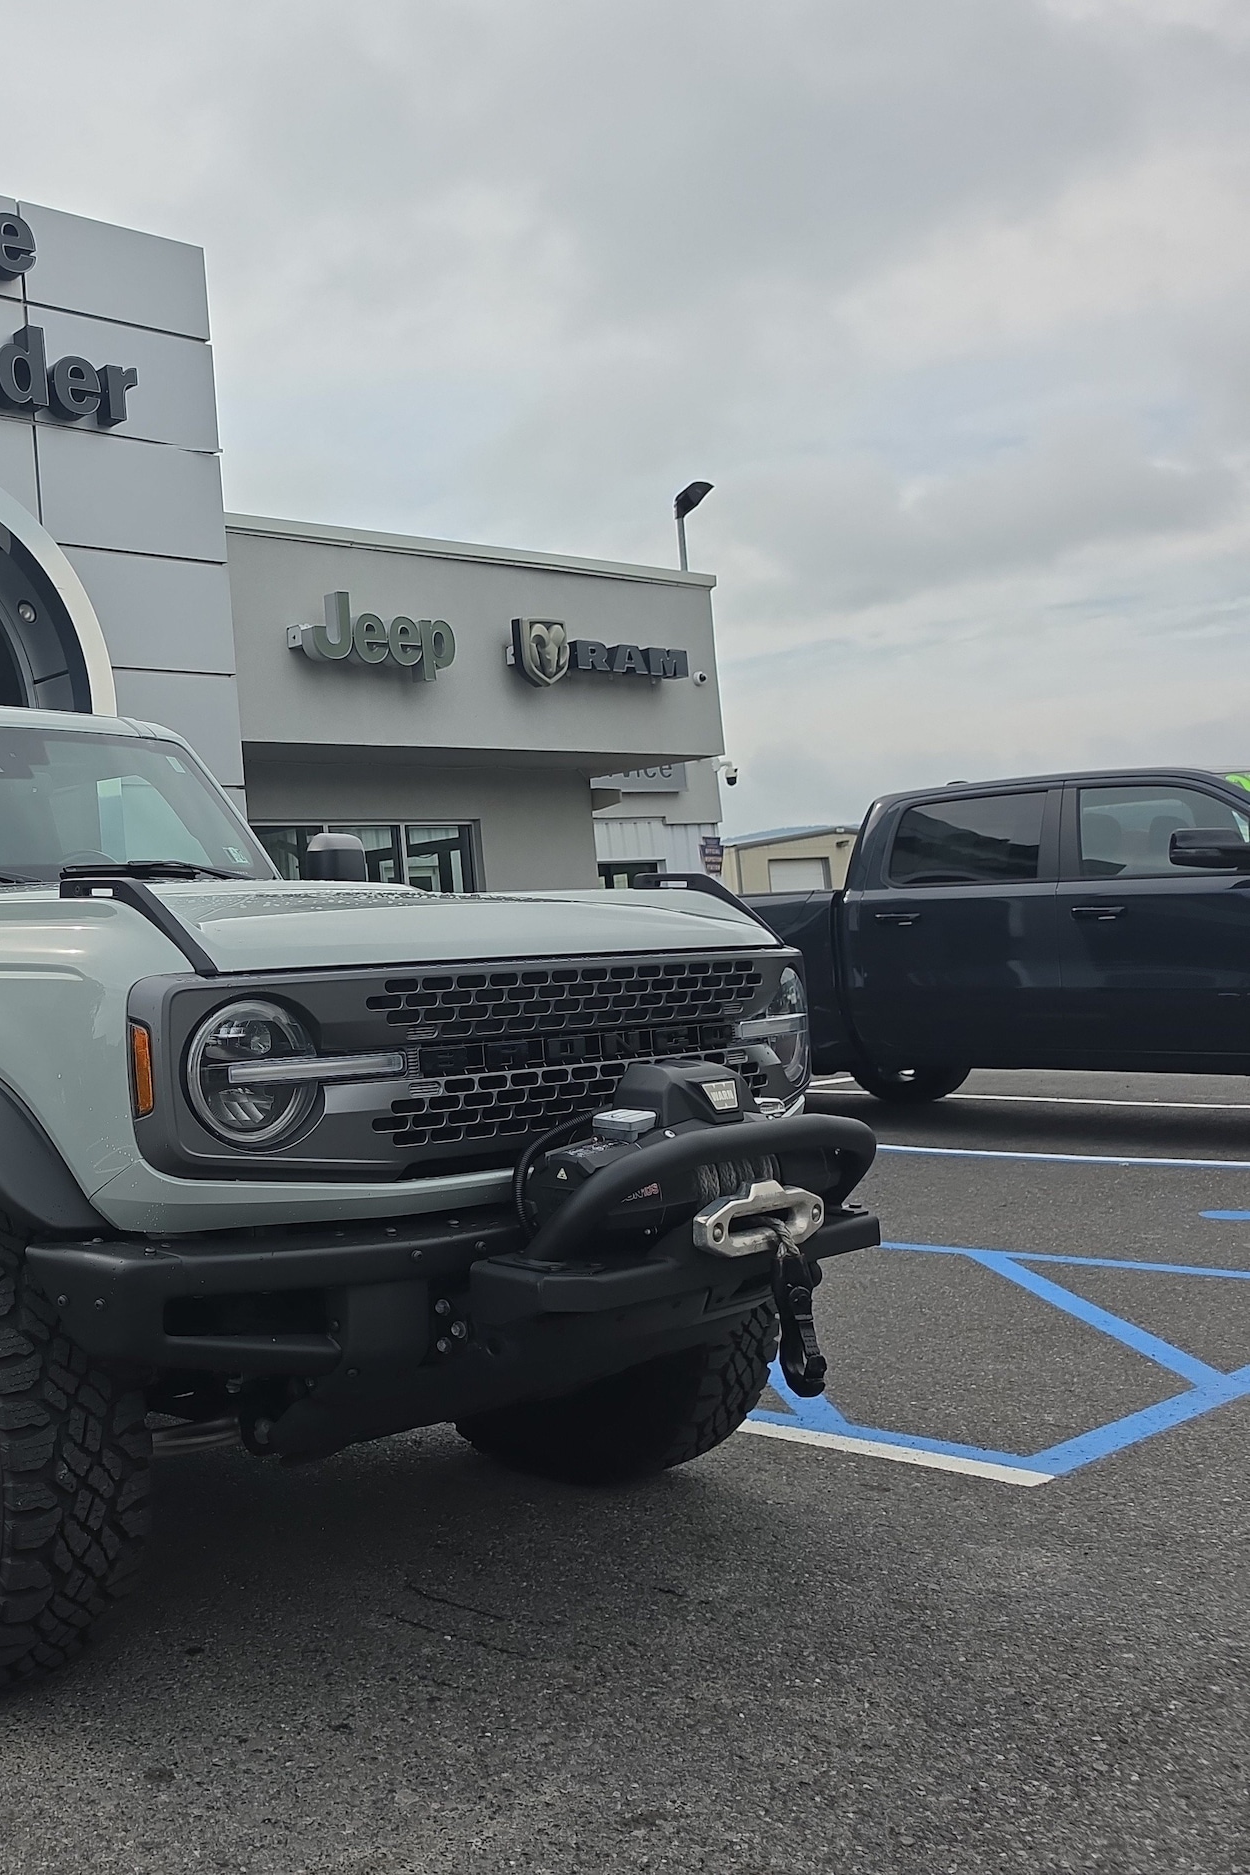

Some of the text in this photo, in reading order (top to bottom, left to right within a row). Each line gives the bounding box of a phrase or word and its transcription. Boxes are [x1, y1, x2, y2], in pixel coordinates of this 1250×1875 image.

[300, 590, 456, 682] Jeep
[570, 640, 689, 680] RAM
[419, 1024, 733, 1075] BRONCO
[710, 1089, 734, 1102] WARN
